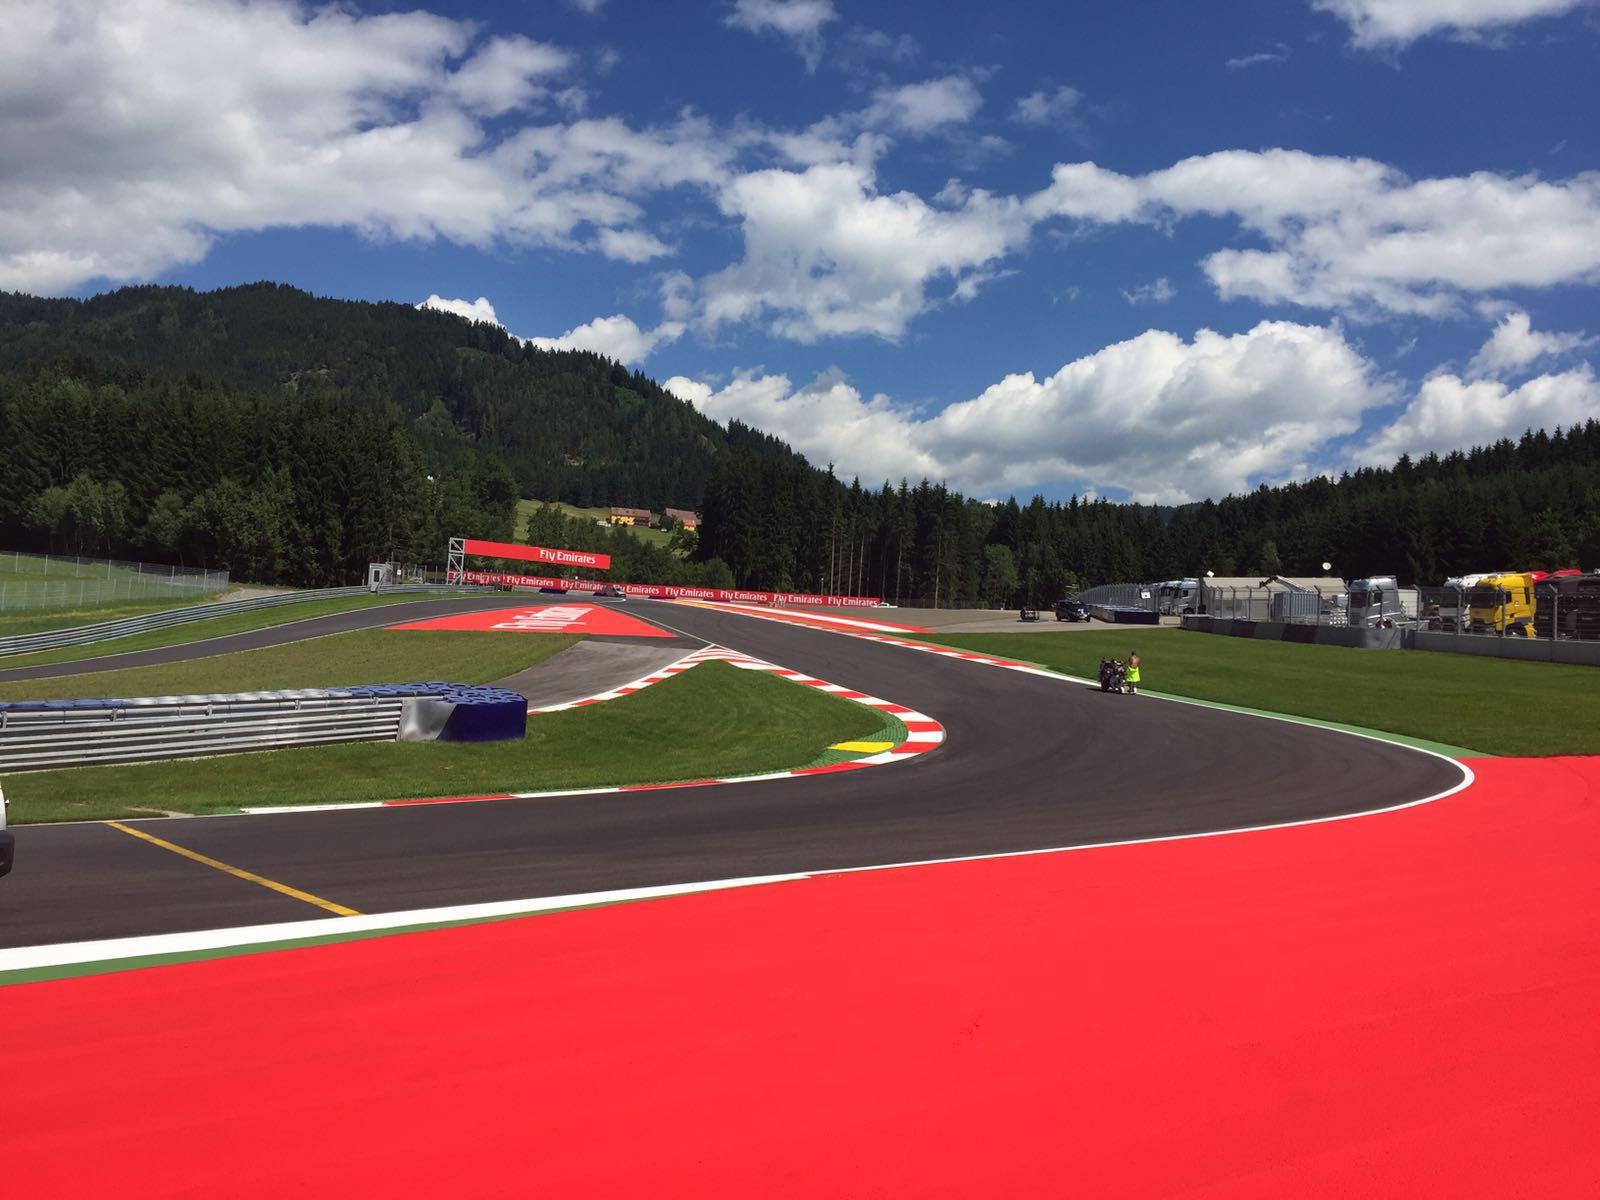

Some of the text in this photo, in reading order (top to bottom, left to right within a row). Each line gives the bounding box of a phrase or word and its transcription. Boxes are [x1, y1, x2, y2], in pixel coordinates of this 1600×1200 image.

[540, 550, 596, 564] Fly Emirates
[507, 576, 554, 587] Fly Emirates
[560, 580, 574, 589] Fly
[626, 585, 660, 595] Emirates
[665, 587, 714, 598] Fly Emirates
[720, 590, 767, 601] Fly Emirates
[773, 594, 823, 605] Fly Emirates
[828, 597, 877, 608] Fly Emirates
